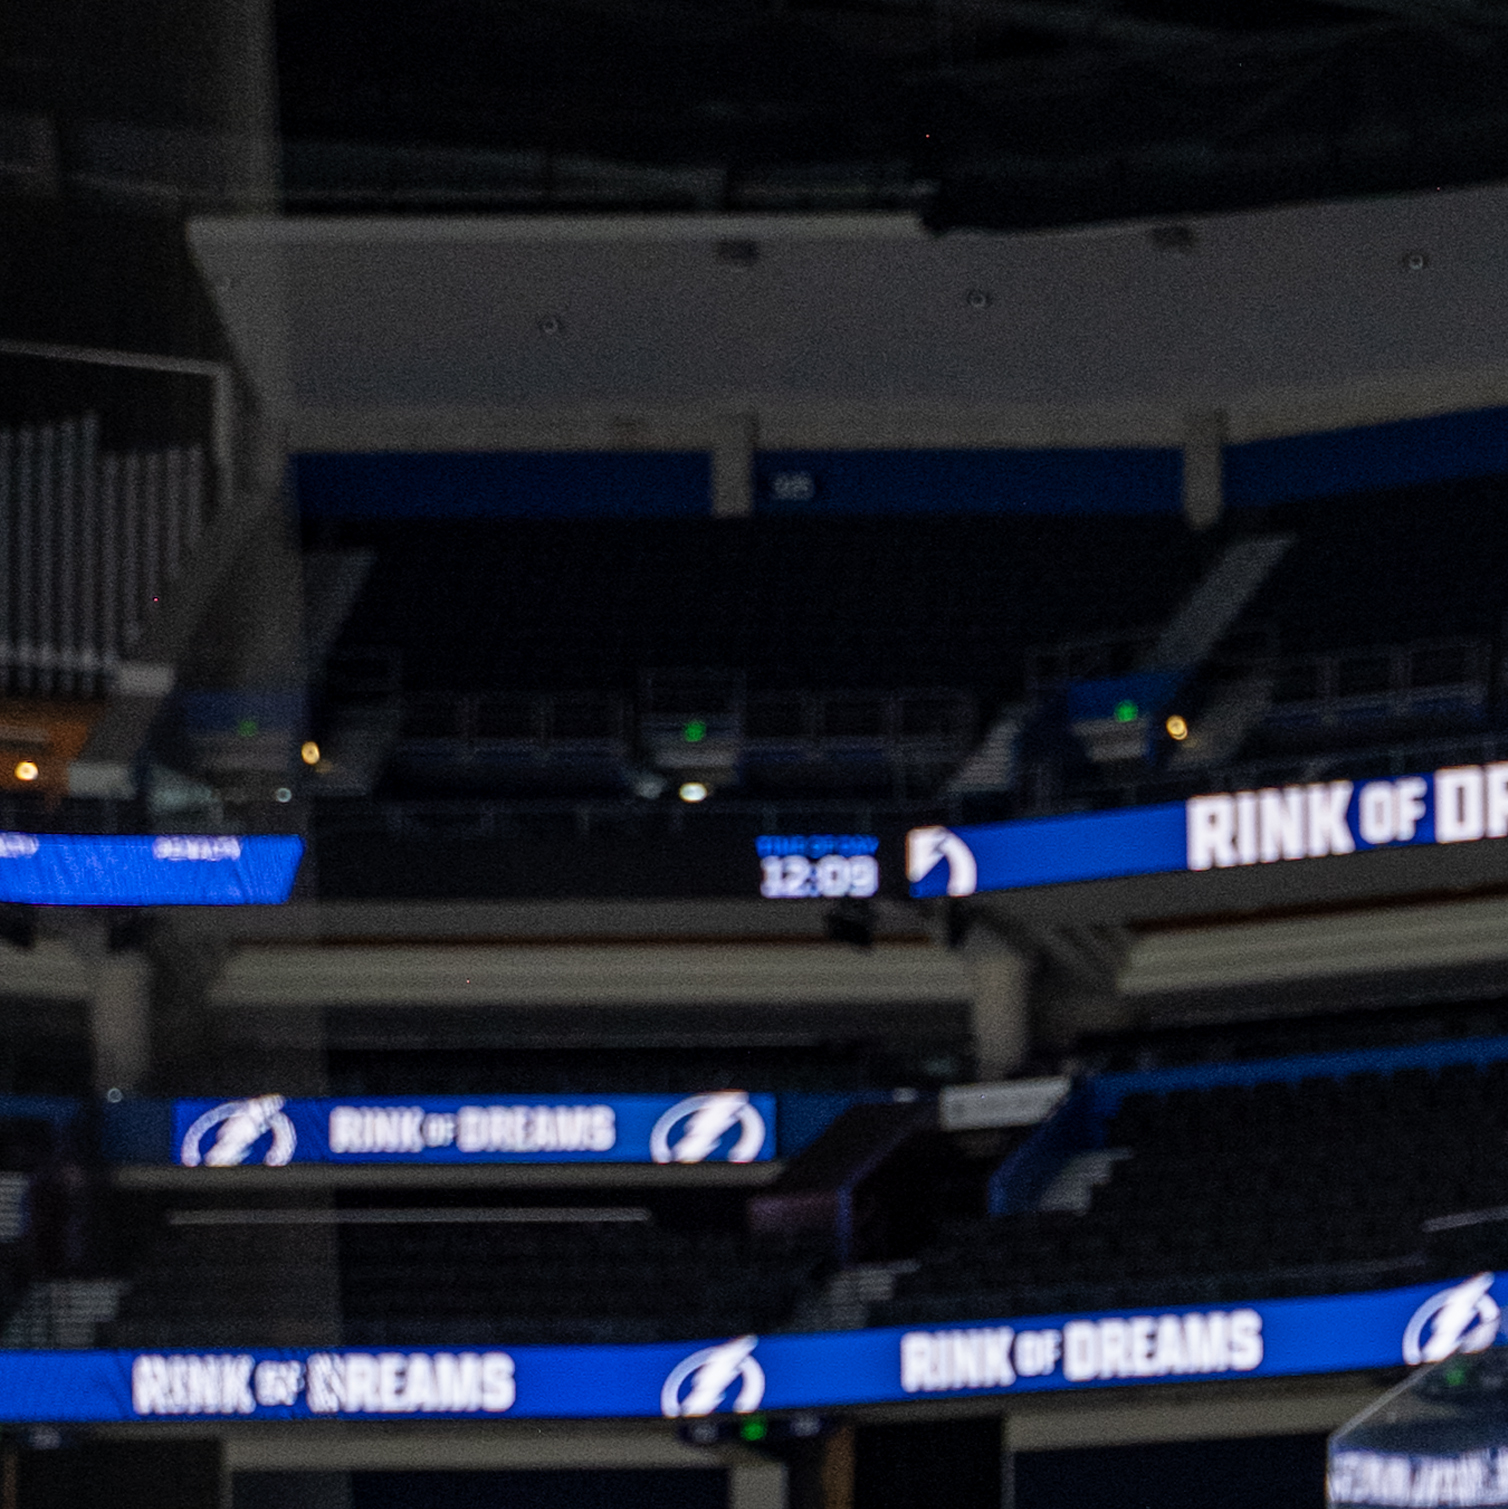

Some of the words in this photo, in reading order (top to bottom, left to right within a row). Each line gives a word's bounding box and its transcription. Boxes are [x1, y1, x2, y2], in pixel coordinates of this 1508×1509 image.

[1187, 780, 1355, 872] RINK
[1359, 775, 1427, 845] OF
[760, 855, 879, 898] 12:09
[329, 1106, 427, 1153] RINK
[428, 1113, 458, 1147] OF
[458, 1104, 617, 1152] DREAMS
[900, 1327, 1016, 1393] RINK
[1014, 1330, 1062, 1377] OF
[1062, 1309, 1265, 1383] DREAMS
[131, 1355, 256, 1415] RINK
[254, 1359, 305, 1406] OF
